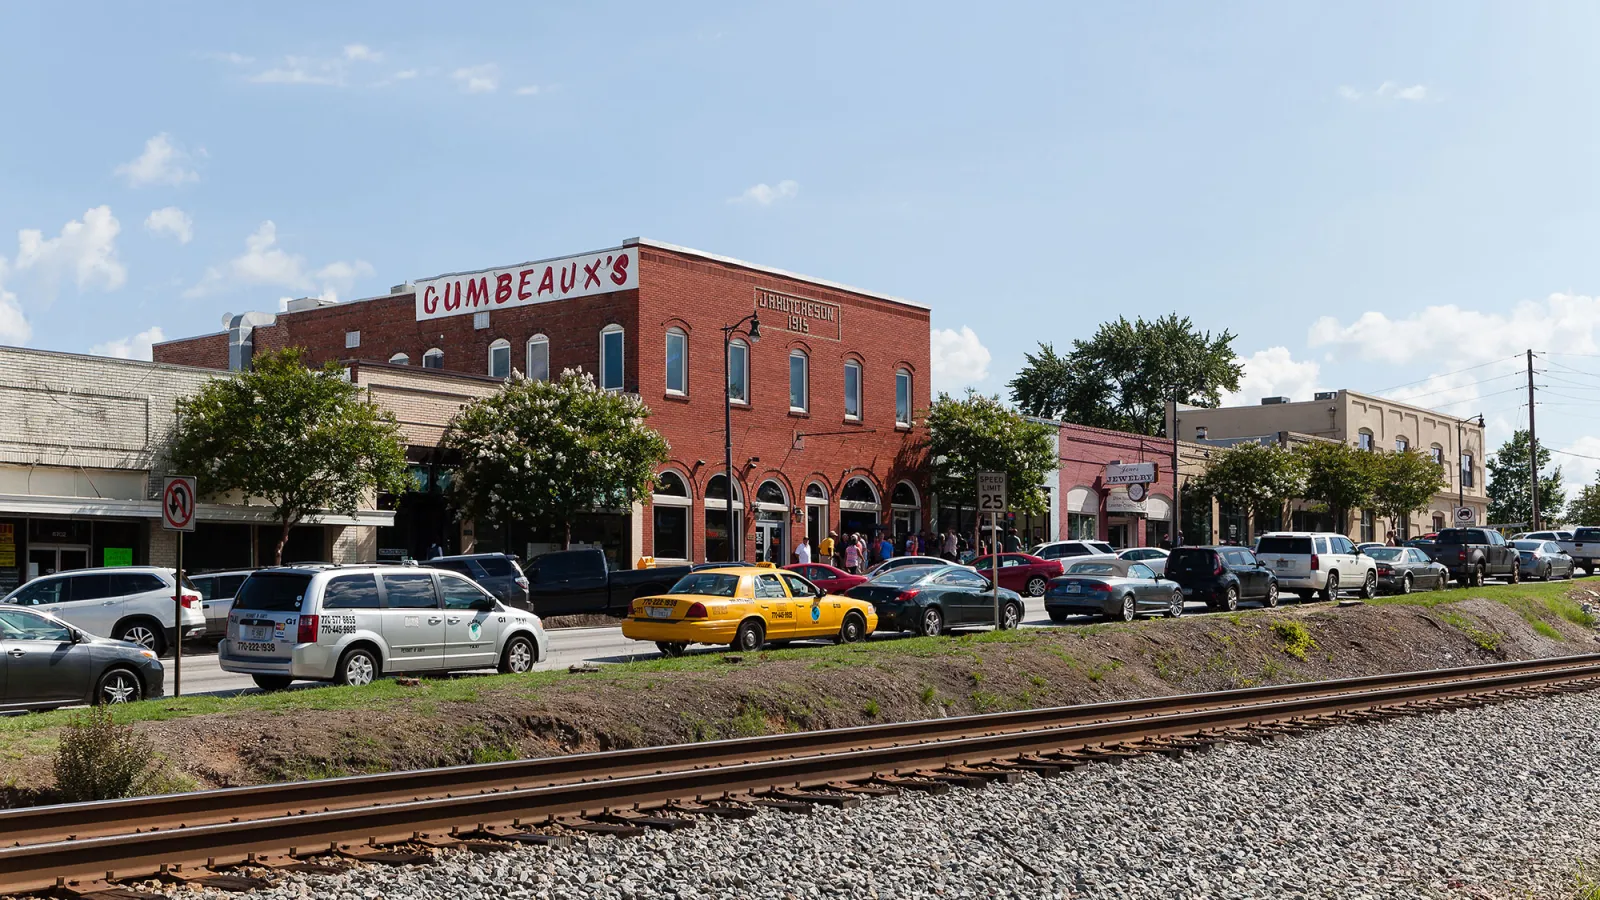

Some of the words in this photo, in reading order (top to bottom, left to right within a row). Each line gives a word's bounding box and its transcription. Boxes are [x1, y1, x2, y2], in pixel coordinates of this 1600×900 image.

[424, 254, 630, 315] GUMBEAUX'S
[787, 315, 810, 334] 1915
[980, 476, 1004, 484] SPEED
[1106, 474, 1153, 482] JEWELRY
[981, 494, 1003, 509] 25
[237, 642, 276, 652] 770-222-1938
